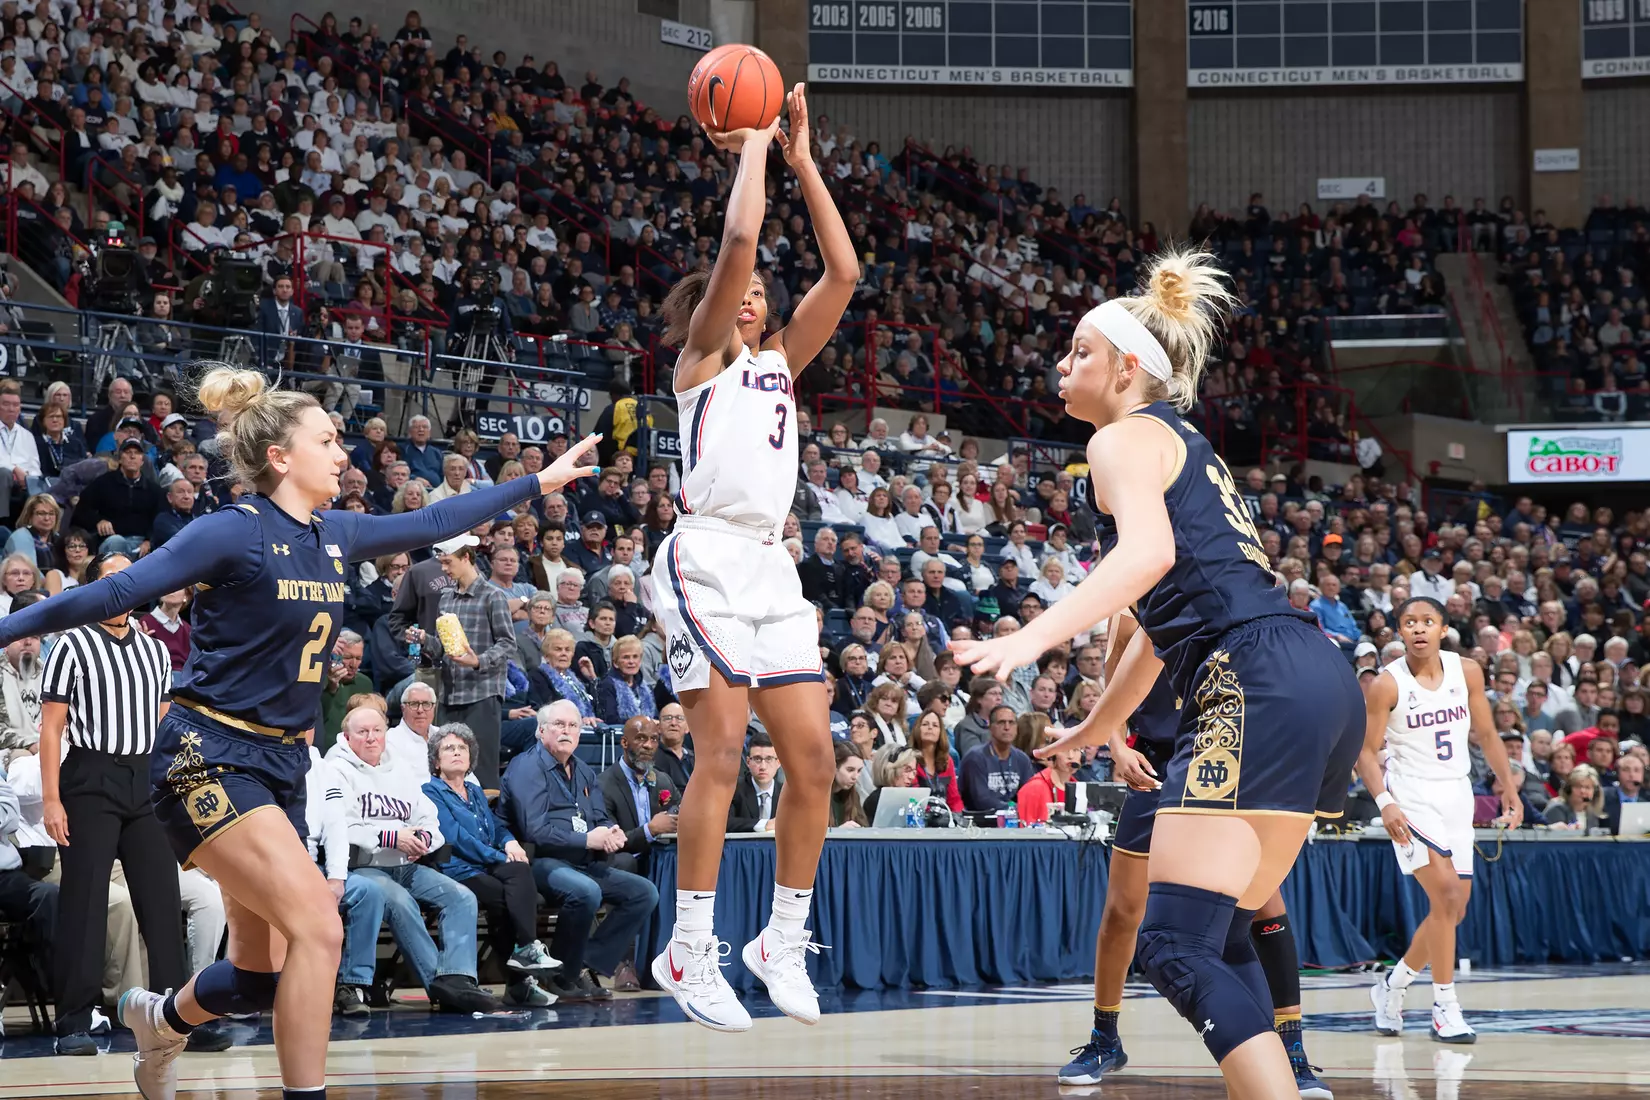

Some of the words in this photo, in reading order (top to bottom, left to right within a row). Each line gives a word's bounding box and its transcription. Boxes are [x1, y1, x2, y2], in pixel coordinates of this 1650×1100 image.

[813, 5, 849, 26] 2003
[860, 6, 896, 27] 2005
[906, 6, 942, 28] 2006
[1193, 9, 1229, 31] 2016
[662, 27, 680, 39] SEC
[687, 29, 711, 48] 212
[817, 67, 940, 81] CONNECTICUT
[949, 70, 1003, 82] MEN'S
[1011, 71, 1123, 84] BASKETBALL
[1197, 70, 1324, 84] CONNECTICUT
[1332, 69, 1387, 81] MEN'S
[1395, 66, 1513, 80] BASKETBALL
[1319, 184, 1341, 194] SEC
[1365, 181, 1376, 194] 4
[479, 417, 508, 433] SEC
[769, 403, 787, 450] 3
[1529, 455, 1618, 473] CABOT
[277, 579, 325, 602] NOTRE
[297, 611, 333, 683] 2
[1406, 705, 1467, 729] UCONN
[1435, 730, 1453, 761] 5
